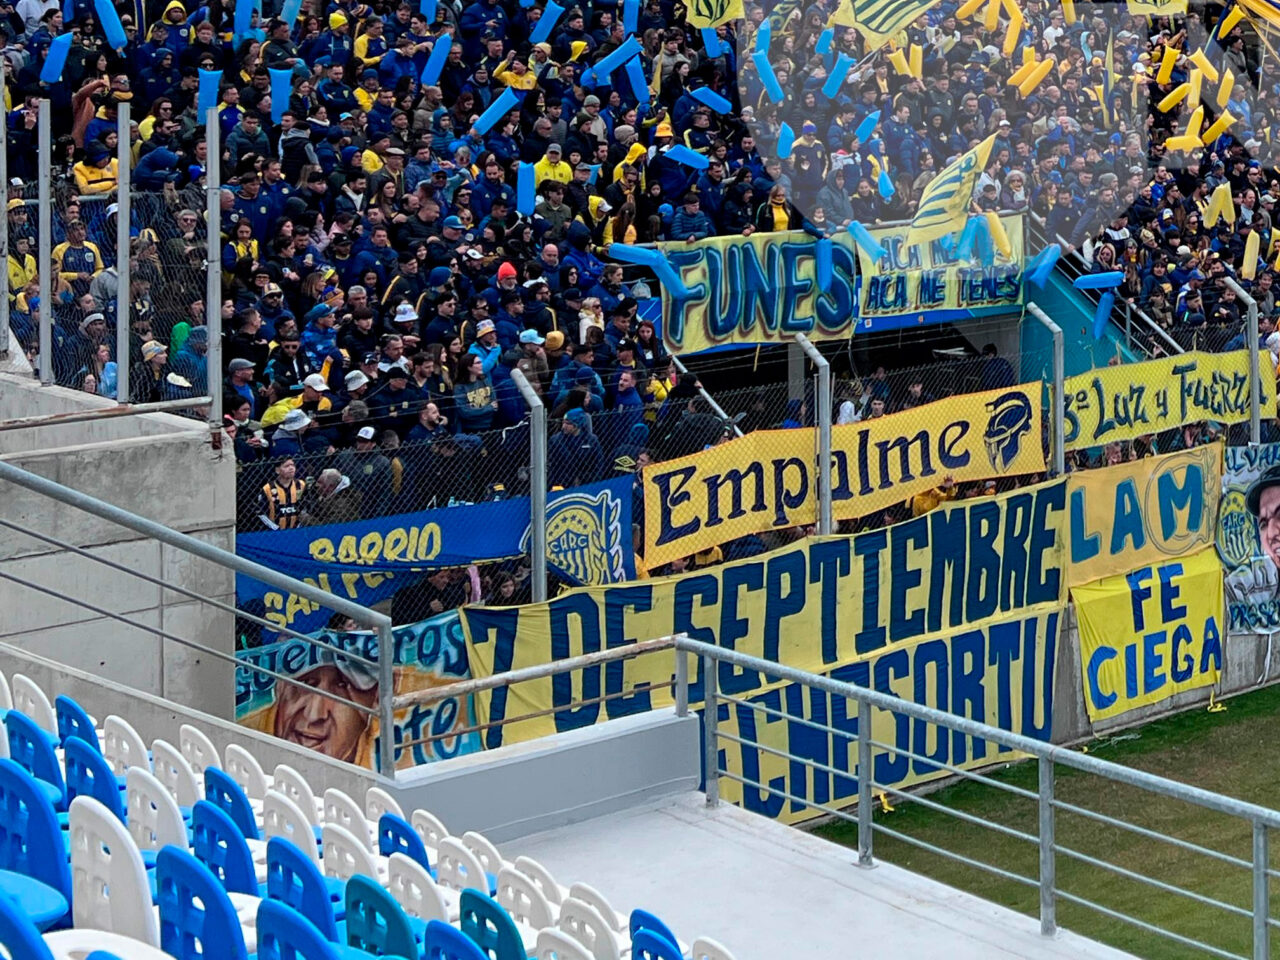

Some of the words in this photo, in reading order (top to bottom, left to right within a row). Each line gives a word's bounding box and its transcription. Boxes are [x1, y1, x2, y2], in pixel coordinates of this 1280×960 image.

[665, 240, 856, 342] FUNES
[279, 506, 297, 515] TCL
[651, 418, 972, 548] Empalme
[466, 606, 519, 751] 7
[549, 584, 654, 735] DE
[672, 482, 1068, 706] SEPTIEMBRE
[1129, 563, 1188, 634] FE
[1086, 615, 1223, 711] CIEGA
